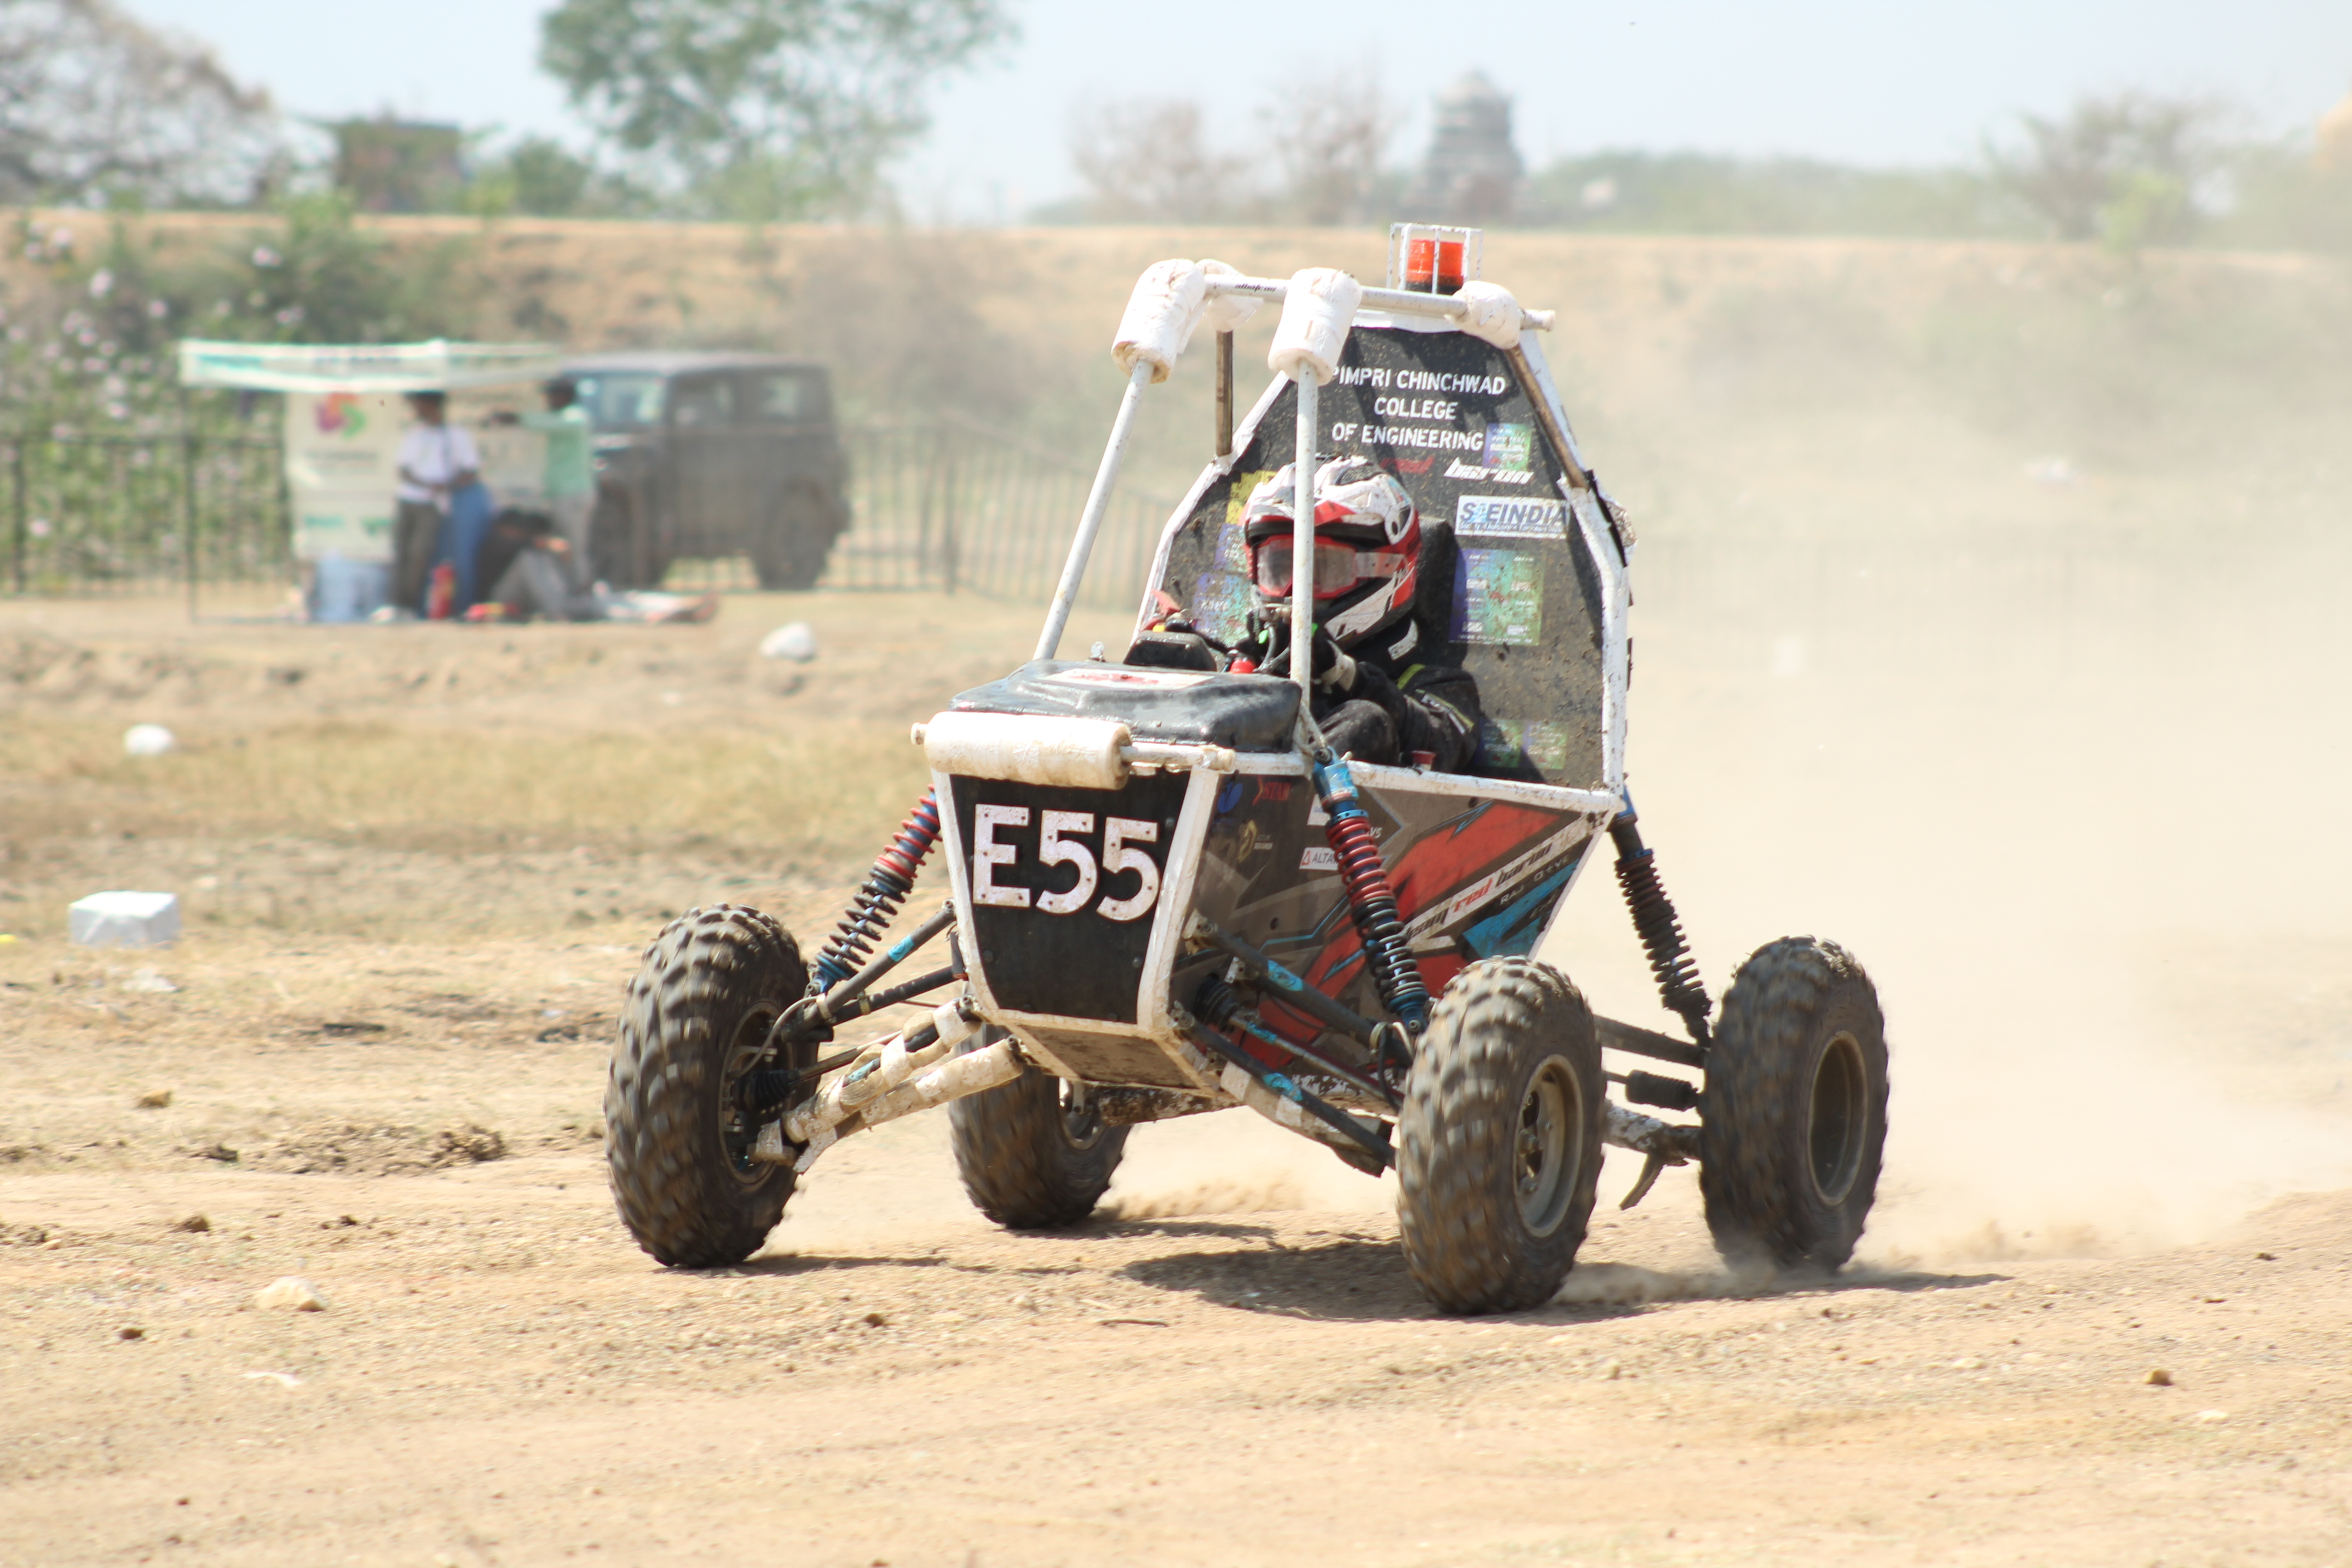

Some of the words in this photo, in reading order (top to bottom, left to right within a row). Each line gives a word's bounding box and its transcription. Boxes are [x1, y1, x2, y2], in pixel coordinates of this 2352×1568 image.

[1396, 369, 1506, 395] CHINCHWAD
[1374, 397, 1458, 421] COLLEGE
[1331, 422, 1357, 441] OF
[1361, 425, 1484, 451] ENGINEERING
[973, 804, 1160, 921] E55
[1453, 878, 1493, 913] red
[1495, 843, 1553, 887] baron
[1500, 885, 1524, 906] RAJ
